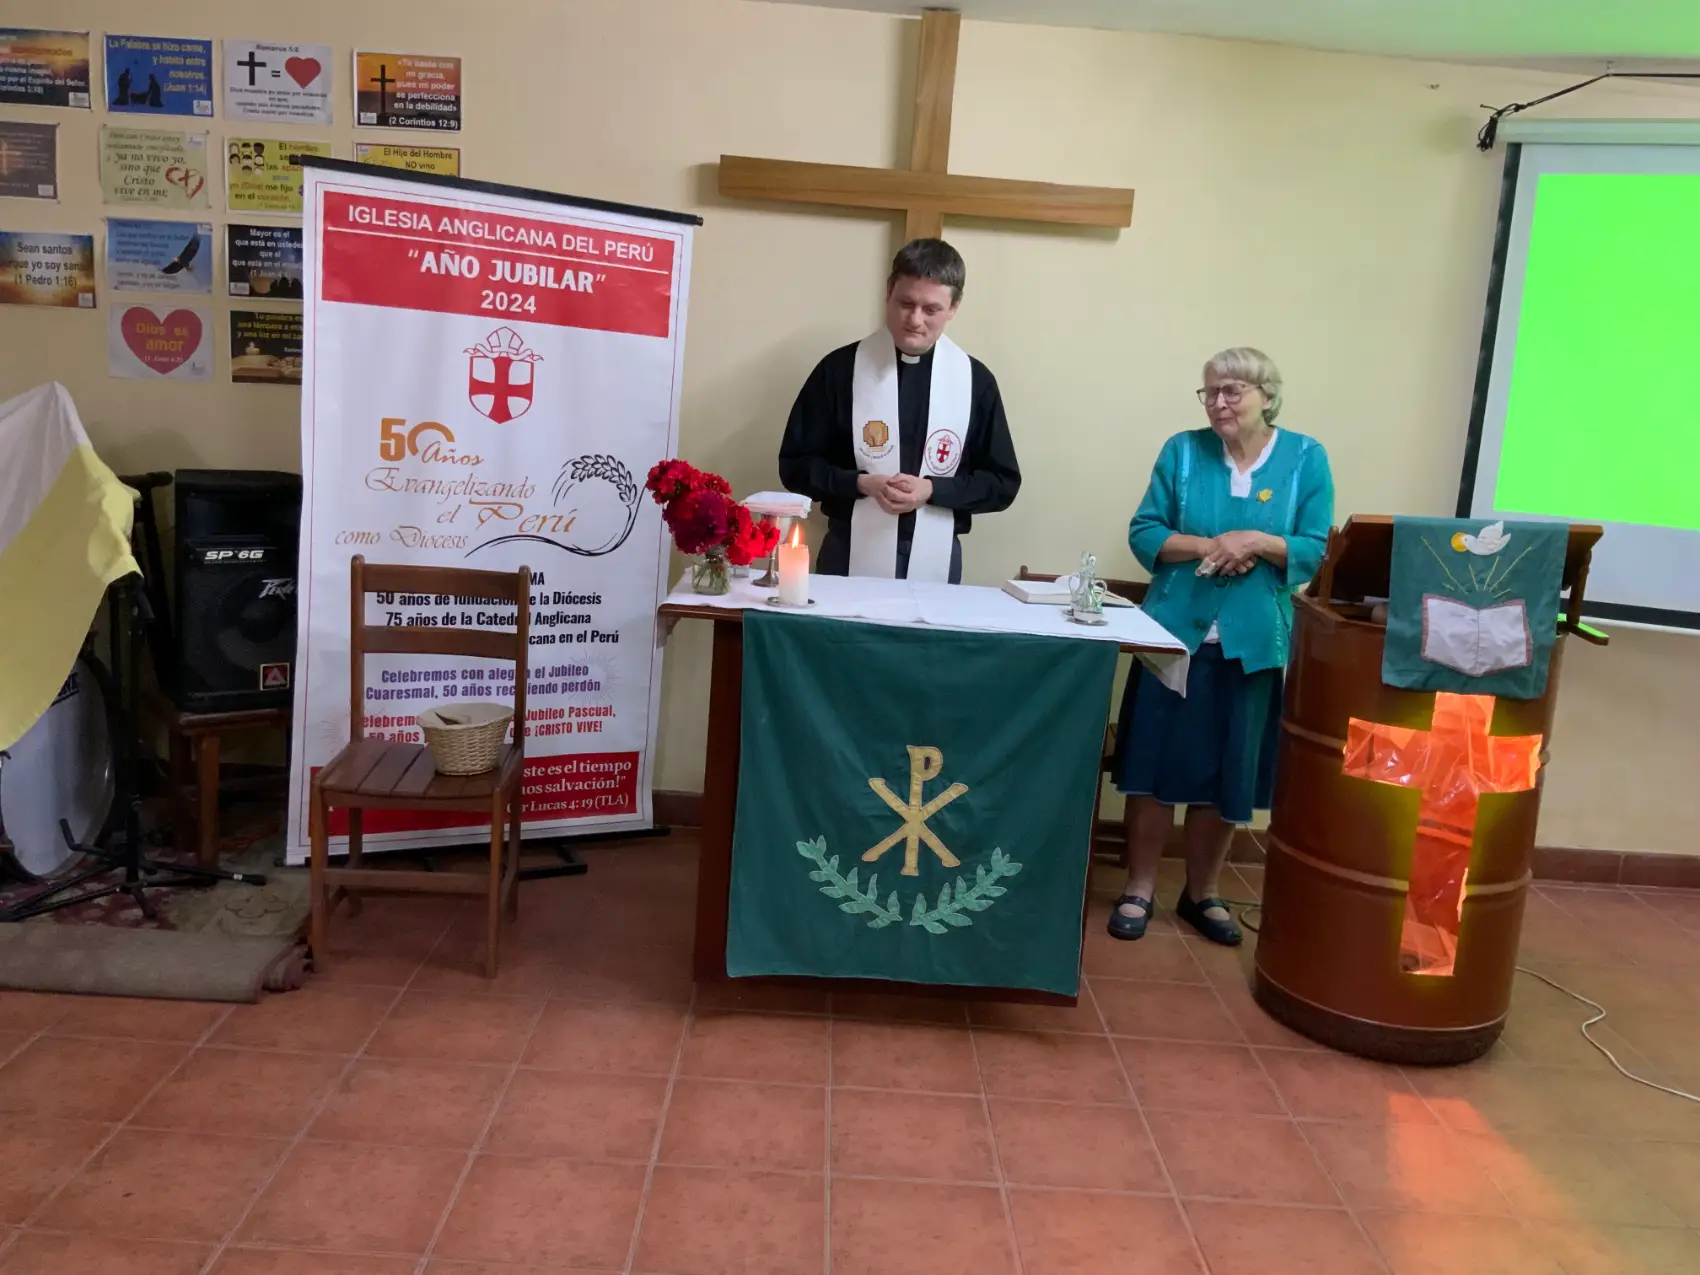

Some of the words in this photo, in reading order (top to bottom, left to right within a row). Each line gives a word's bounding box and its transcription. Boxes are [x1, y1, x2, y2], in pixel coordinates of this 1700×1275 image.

[110, 40, 118, 48] La
[121, 39, 150, 49] Palabra
[415, 60, 437, 68] basta
[396, 81, 416, 89] pues
[431, 82, 455, 90] poder
[408, 92, 455, 101] perfecciona
[406, 101, 413, 109] la
[389, 117, 397, 125] (2
[399, 117, 436, 126] Corintios
[439, 119, 458, 129] 12:9)
[147, 154, 168, 162] vivo
[384, 148, 391, 156] El
[393, 148, 407, 158] Hijo
[410, 149, 421, 157] del
[423, 150, 452, 159] Hombre
[143, 165, 161, 175] que
[405, 161, 417, 169] NO
[418, 162, 435, 170] vino
[124, 175, 155, 185] Cristo
[114, 187, 135, 195] vive
[250, 229, 272, 238] Mayor
[348, 205, 433, 232] IGLESIA
[438, 220, 557, 249] ANGLICANA
[562, 235, 599, 255] DEL
[604, 239, 655, 263] PERÚ
[17, 242, 39, 253] Sean
[42, 245, 72, 255] santos
[32, 262, 42, 271] yo
[45, 262, 61, 272] soy
[26, 274, 52, 285] Pedro
[56, 276, 77, 288] 1:16)
[480, 289, 537, 314] 2024
[136, 322, 166, 335] Dios
[173, 327, 189, 336] es
[146, 339, 183, 351] amor
[365, 467, 535, 504] Evangelizando
[436, 504, 462, 524] el
[469, 499, 578, 535] Perú
[335, 530, 381, 545] como
[205, 551, 234, 559] SP
[238, 550, 264, 558] 6G
[376, 592, 394, 605] 50
[434, 594, 450, 606] de
[529, 595, 536, 605] e
[540, 592, 549, 605] la
[553, 591, 602, 605] Diócesis
[386, 612, 402, 626] 75
[407, 613, 438, 627] años
[442, 612, 457, 626] de
[461, 611, 472, 626] la
[535, 611, 591, 627] Anglicana
[559, 634, 573, 643] en
[576, 631, 587, 643] el
[591, 630, 619, 643] Perú
[382, 669, 457, 683] Celebremos
[461, 670, 484, 681] con
[535, 666, 545, 678] el
[549, 664, 589, 678] Jubileo
[366, 686, 438, 700] Cuaresmal,
[443, 685, 458, 697] 50
[462, 684, 492, 697] años
[496, 682, 558, 696] reciendo
[561, 679, 601, 694] perdón
[568, 705, 616, 718] Pascual,
[390, 731, 420, 742] años
[535, 722, 572, 737] ¡CRISTO
[577, 721, 602, 733] VIVE!
[523, 766, 545, 777] ste
[548, 764, 562, 775] es
[564, 760, 577, 773] el
[580, 760, 631, 775] tiempo
[545, 776, 626, 793] salvación!"
[530, 800, 566, 811] Lucas
[568, 800, 579, 810] 4:
[581, 799, 593, 809] 19
[595, 793, 629, 809] (TLA)
